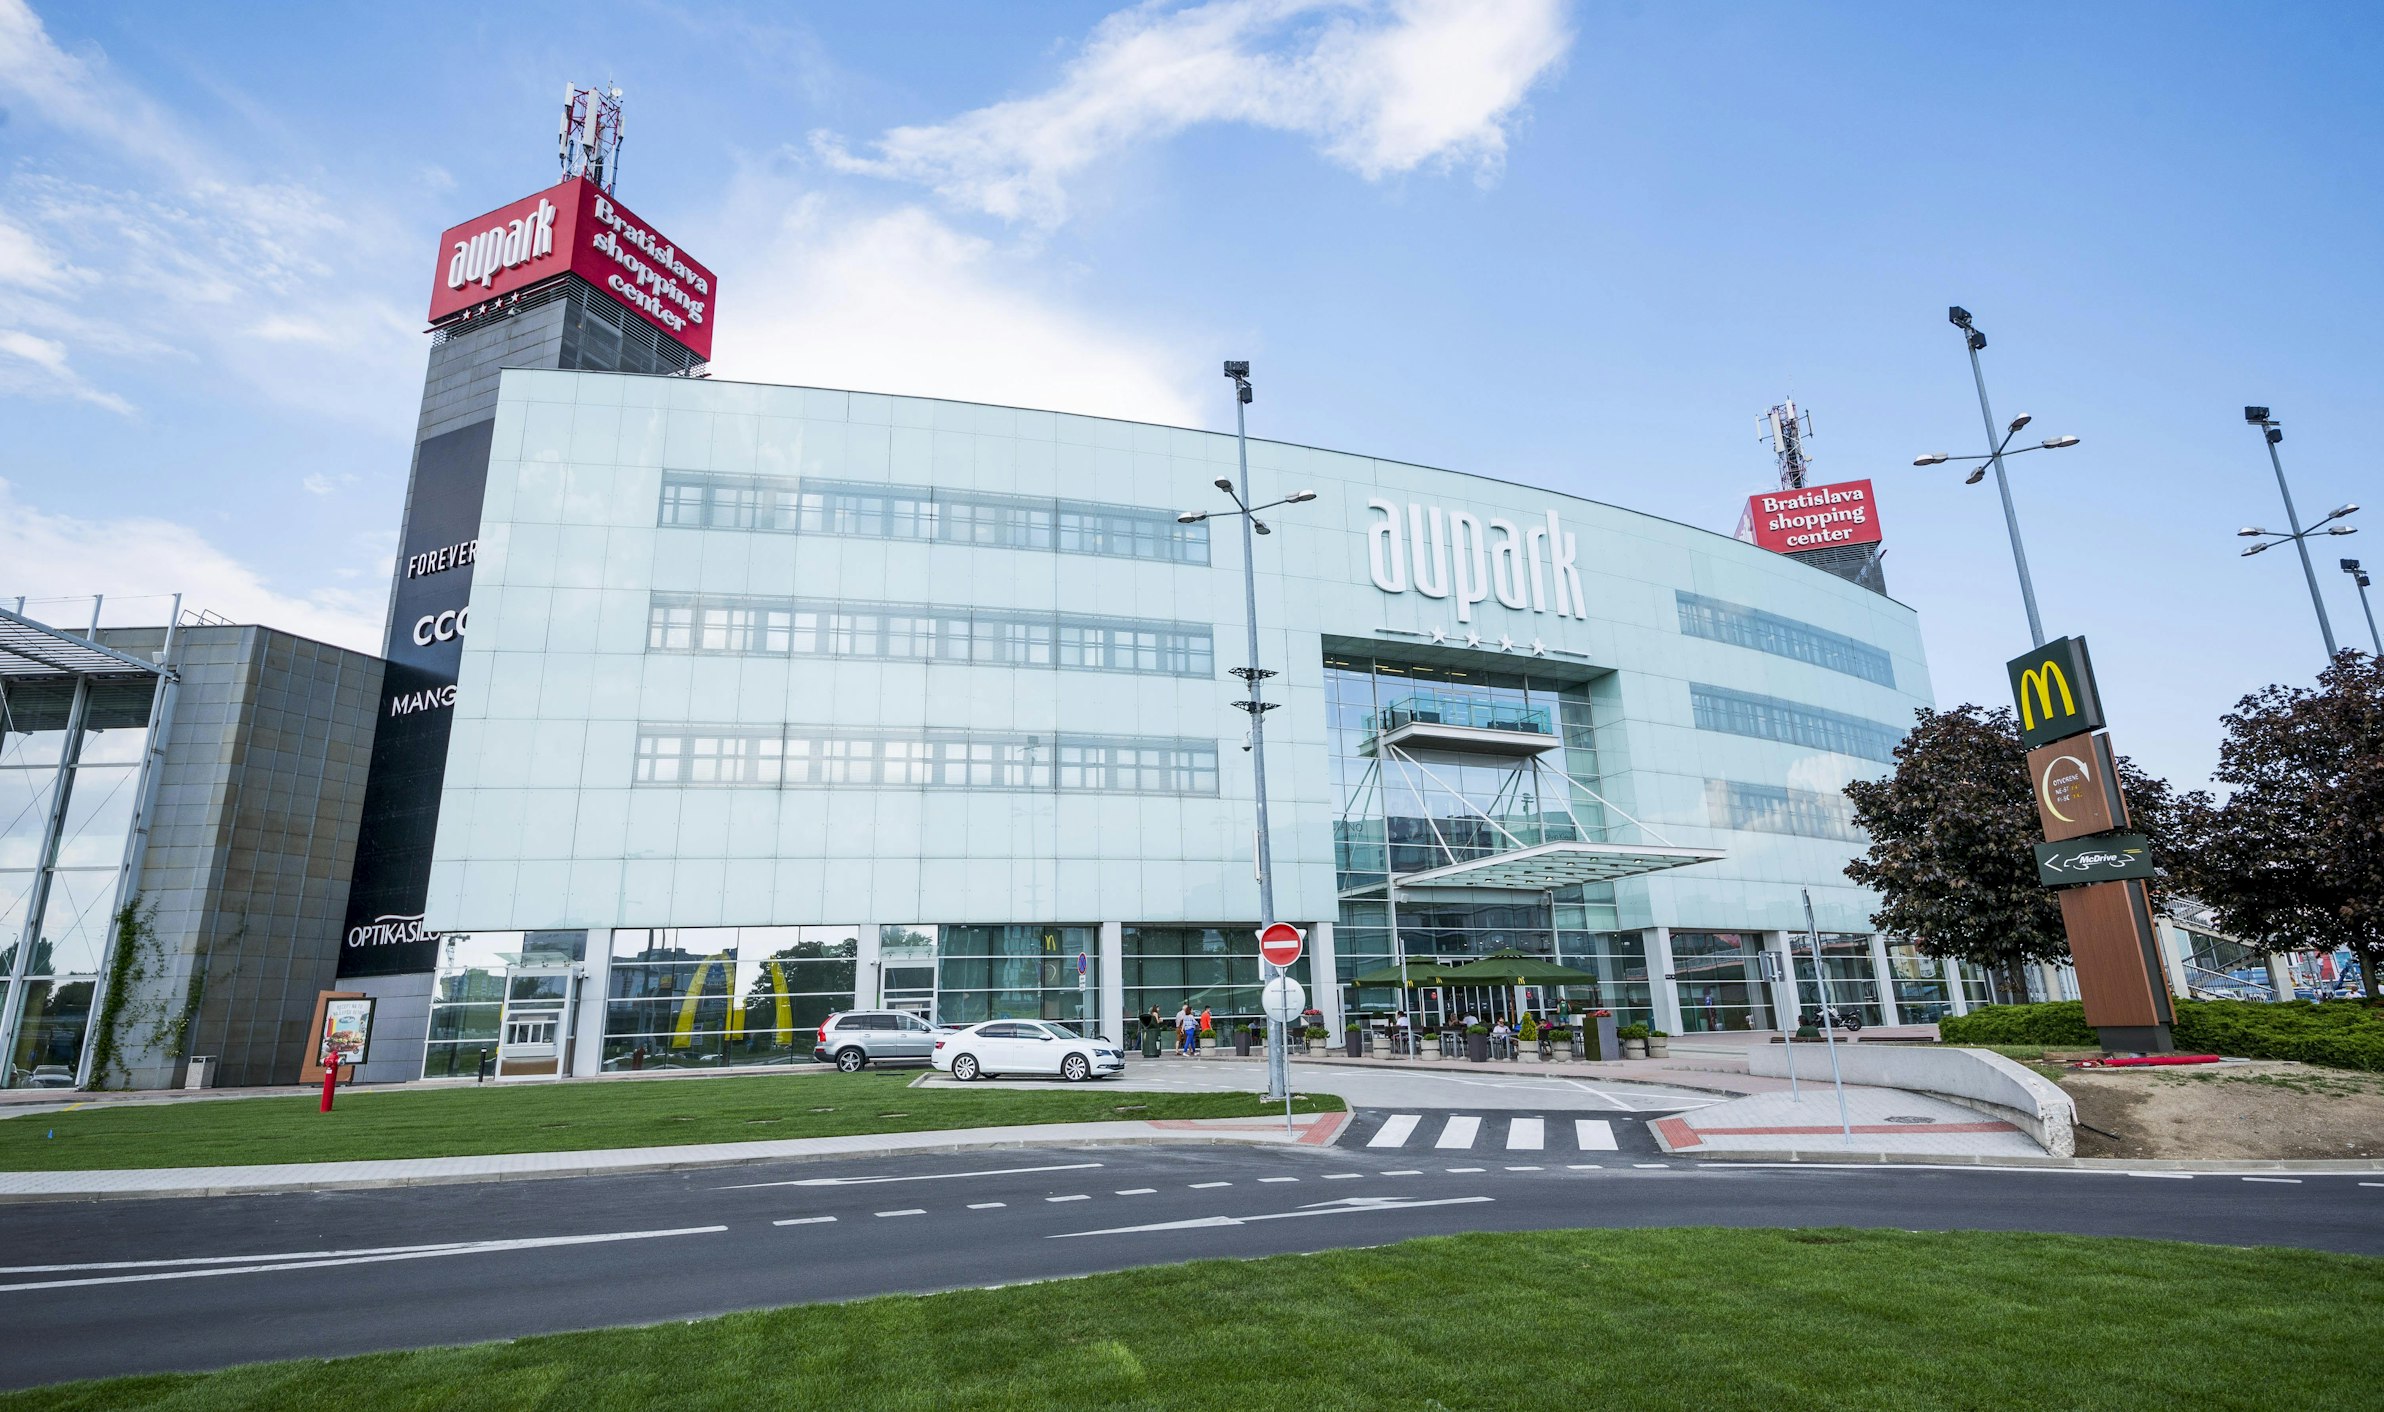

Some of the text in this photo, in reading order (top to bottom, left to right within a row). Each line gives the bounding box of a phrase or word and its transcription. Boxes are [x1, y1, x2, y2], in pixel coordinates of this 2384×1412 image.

[447, 198, 556, 289] aupark
[593, 194, 708, 296] Bratislava
[592, 231, 705, 324] shopping
[607, 274, 686, 332] center
[1761, 488, 1864, 513] Bratislava
[1769, 505, 1865, 531] shopping
[407, 539, 479, 579] FOREVER
[1367, 498, 1587, 623] aupark
[1786, 528, 1853, 546] center
[2079, 854, 2118, 864] McDrive
